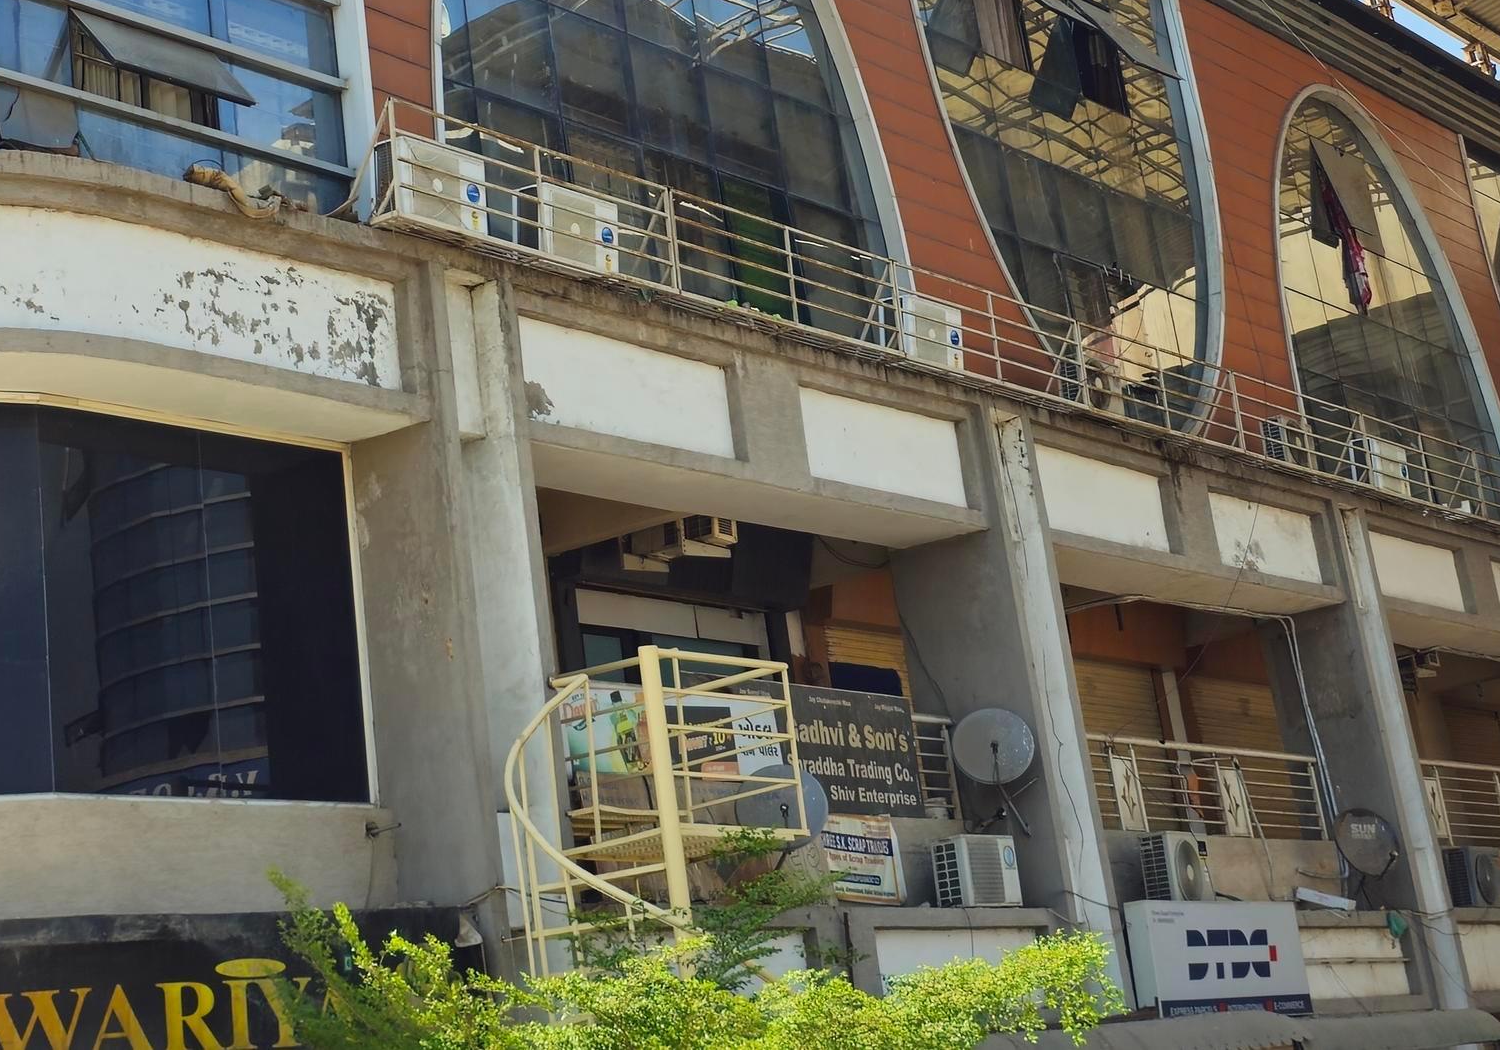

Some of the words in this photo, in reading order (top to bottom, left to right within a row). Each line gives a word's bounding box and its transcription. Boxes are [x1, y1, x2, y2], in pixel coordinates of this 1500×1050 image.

[788, 719, 845, 747] adhvi
[848, 722, 862, 749] &
[863, 724, 909, 752] Son's
[846, 758, 893, 785] Trading
[894, 762, 914, 783] Co.
[830, 784, 856, 801] Shiv
[858, 787, 918, 808] Enterprise
[1350, 823, 1376, 834] SUN
[1186, 928, 1272, 981] DTDC
